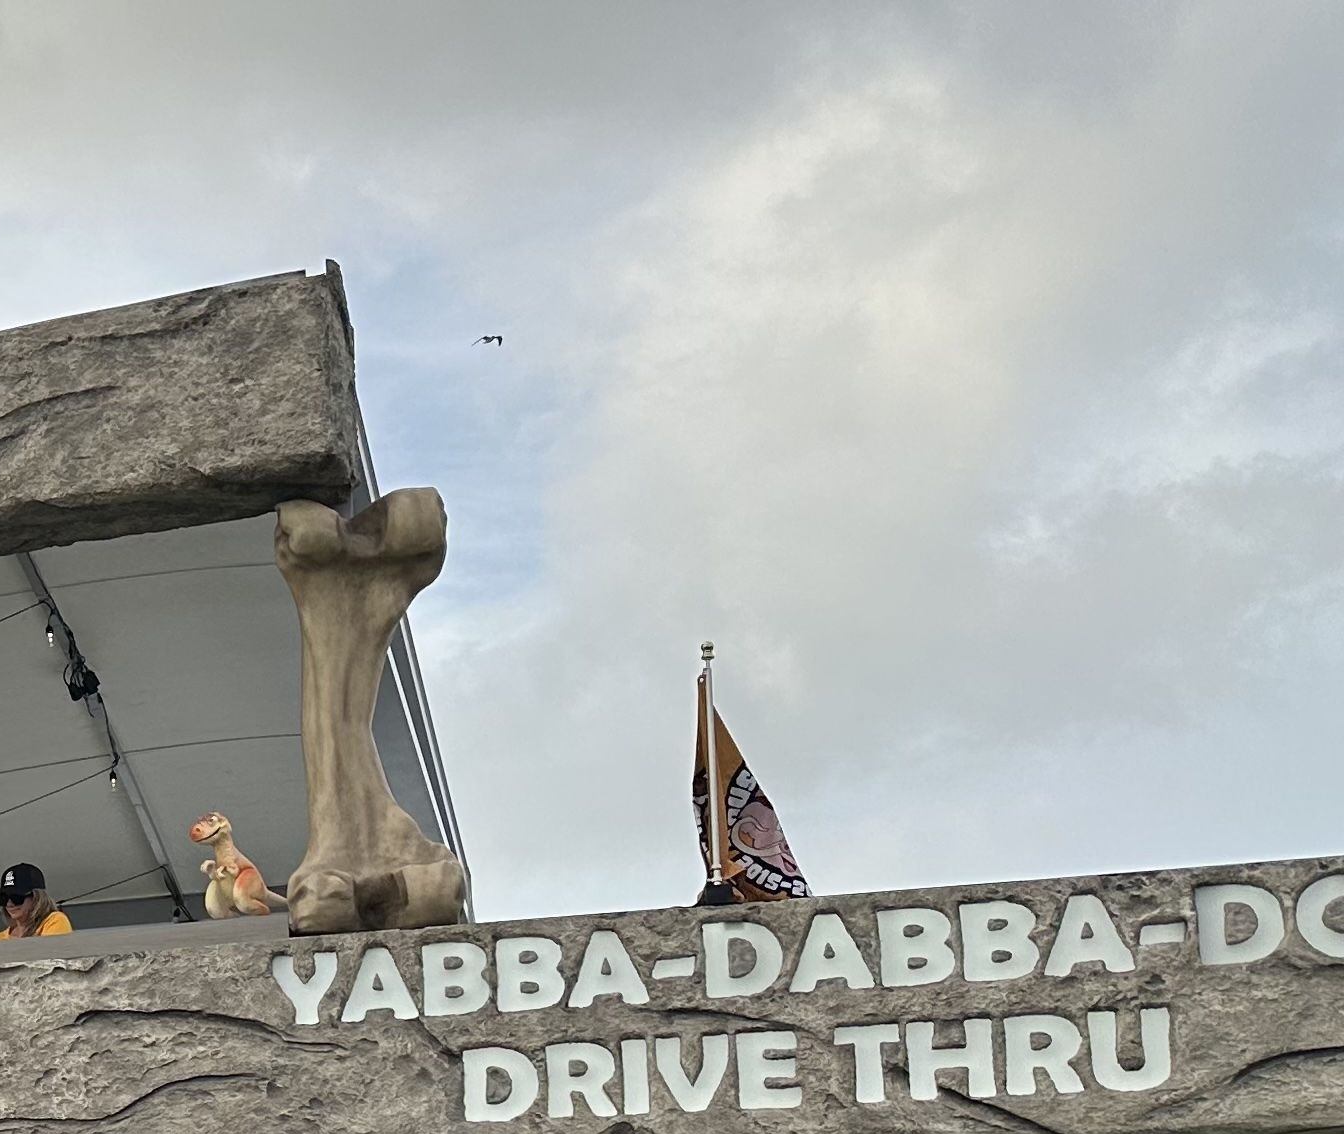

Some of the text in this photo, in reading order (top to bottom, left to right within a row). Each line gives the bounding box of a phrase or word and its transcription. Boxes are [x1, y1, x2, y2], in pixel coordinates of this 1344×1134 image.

[736, 855, 812, 897] 2015-2
[461, 1008, 1172, 1123] DRIVE THRU
